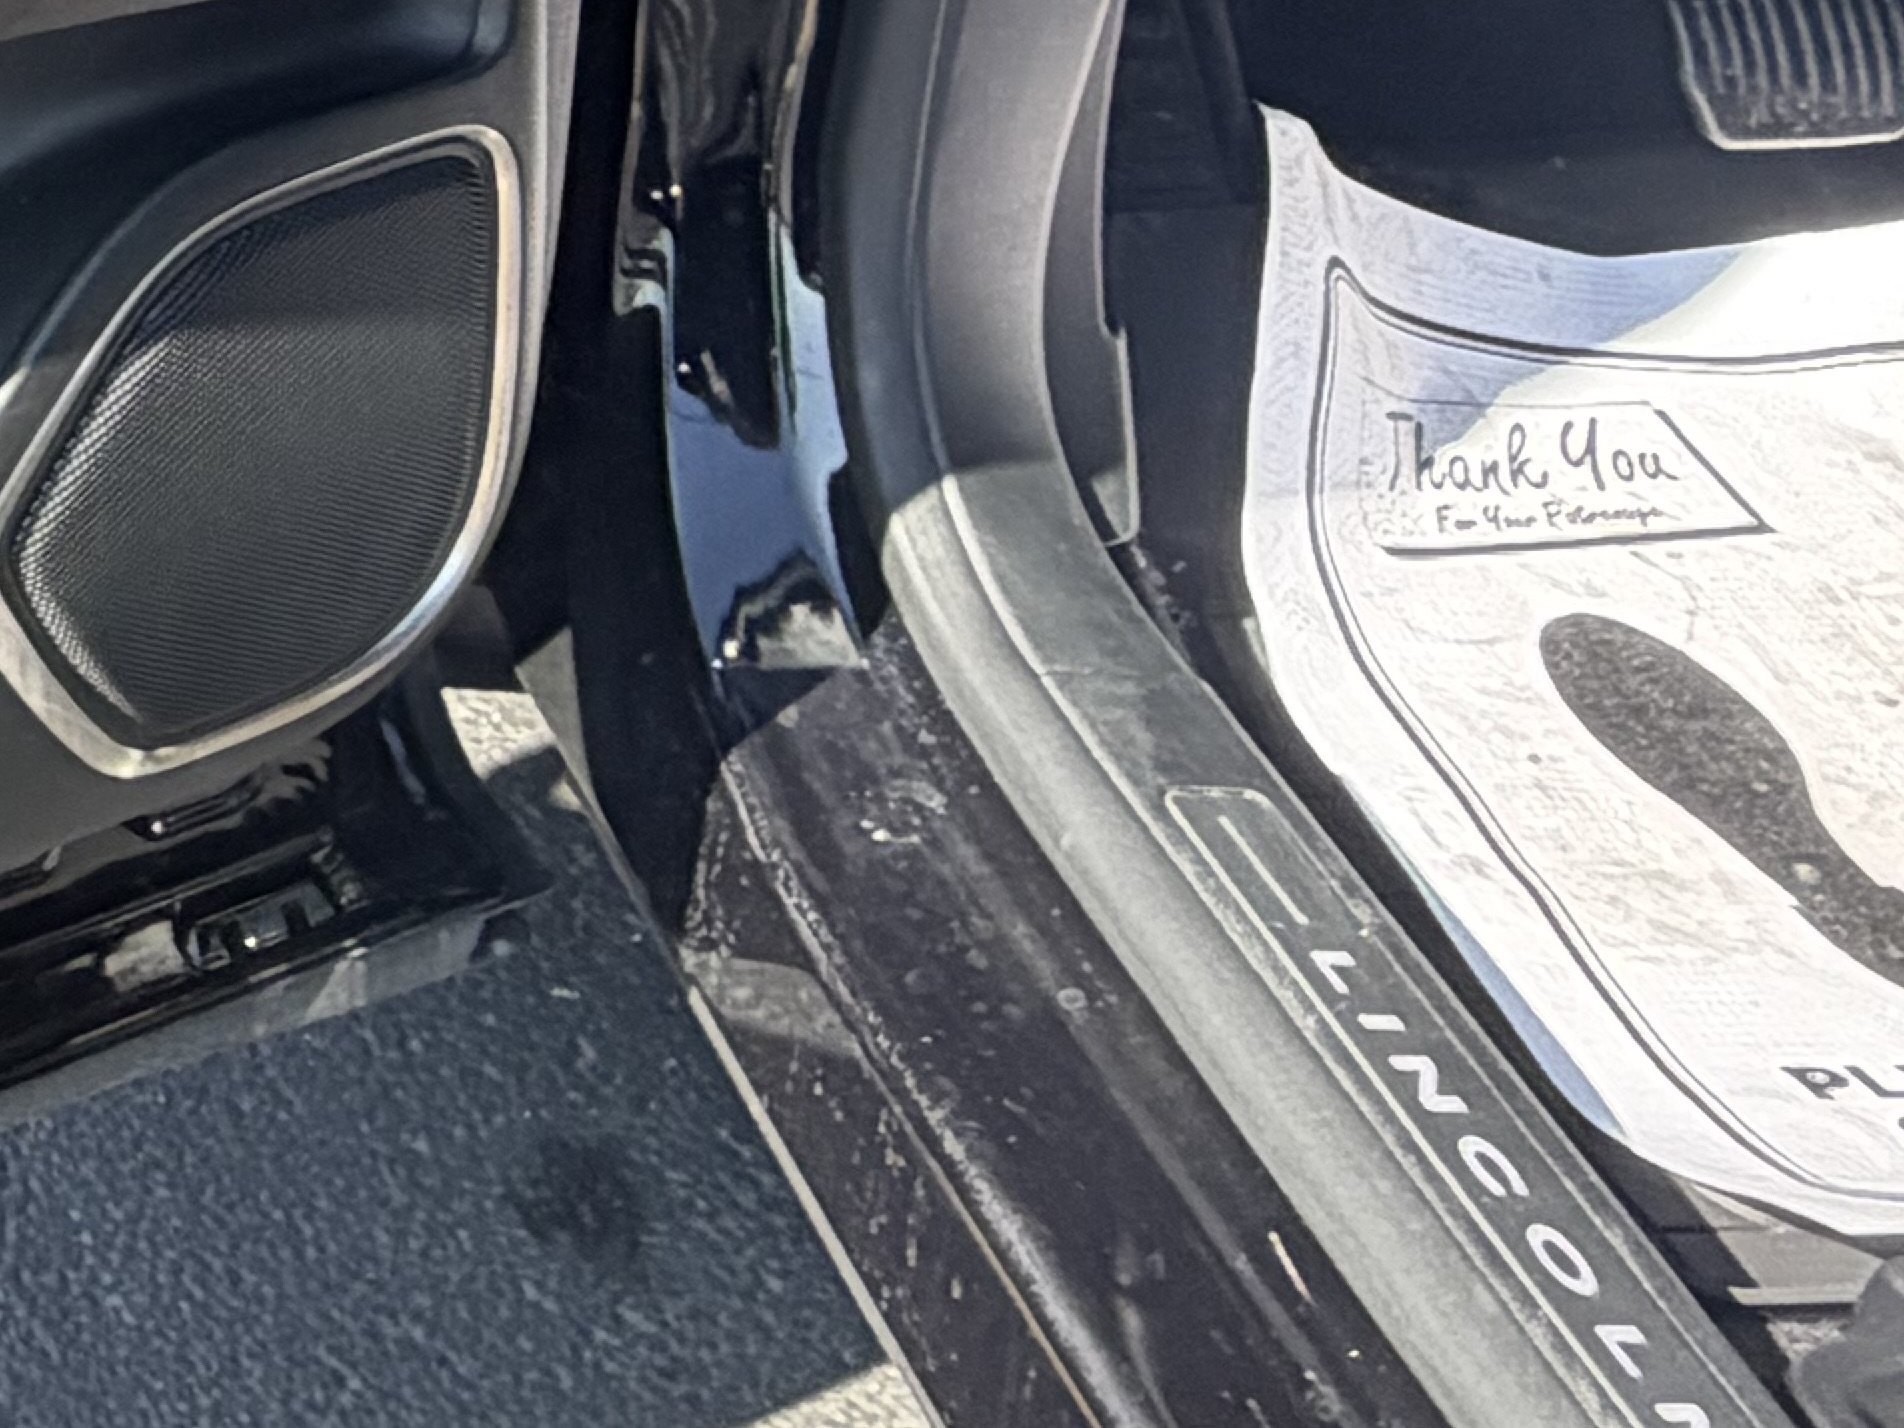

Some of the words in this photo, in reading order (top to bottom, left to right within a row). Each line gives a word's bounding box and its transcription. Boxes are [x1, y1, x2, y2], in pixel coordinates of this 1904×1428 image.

[1386, 411, 1550, 497] Thank
[1559, 416, 1680, 492] You
[1780, 1065, 1904, 1099] PL
